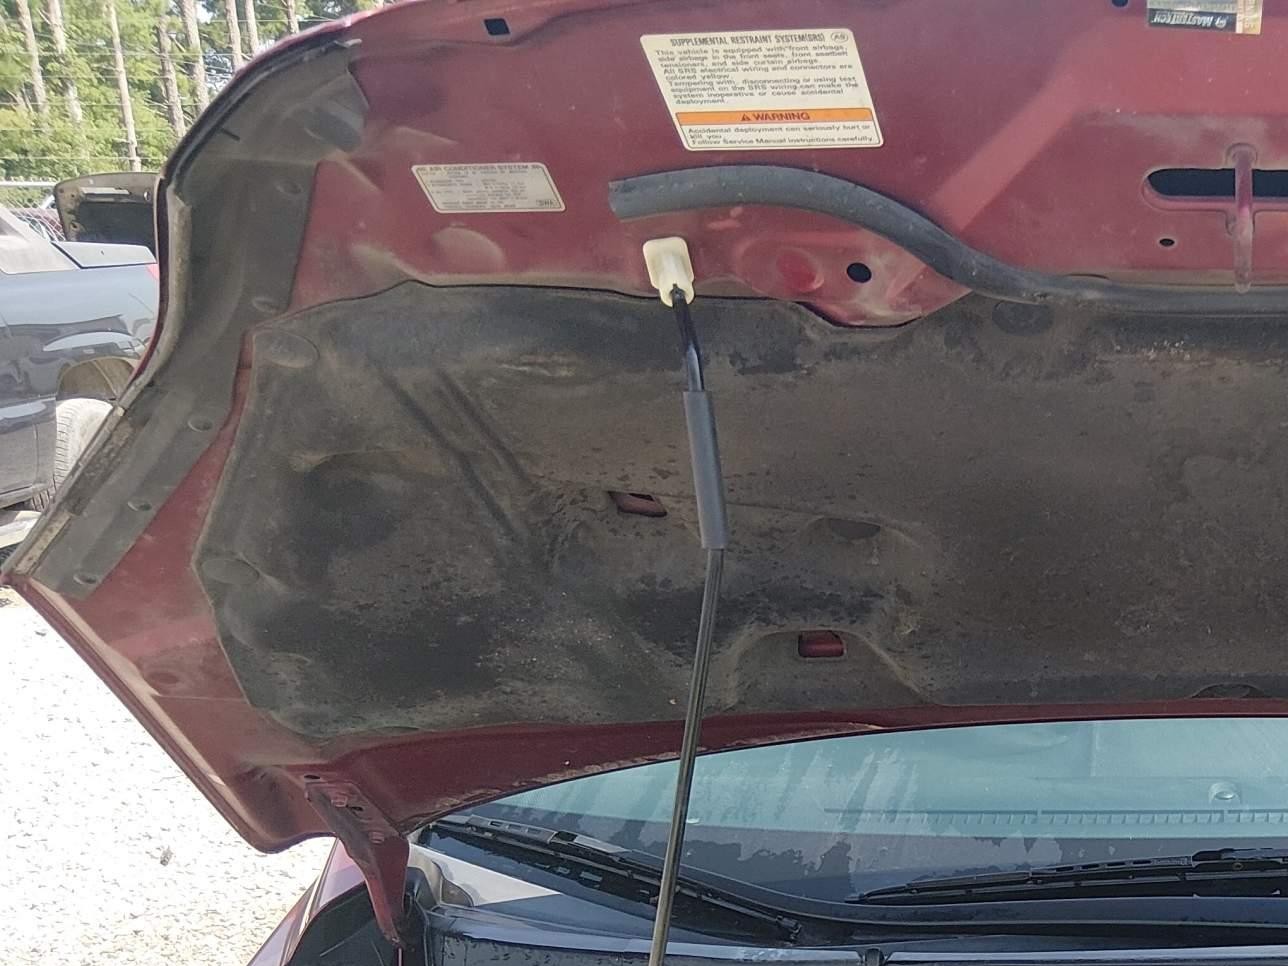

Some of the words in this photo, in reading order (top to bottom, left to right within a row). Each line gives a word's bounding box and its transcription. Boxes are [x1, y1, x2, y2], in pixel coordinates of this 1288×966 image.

[670, 37, 728, 46] SUPPLEMENTAL
[731, 34, 772, 44] RESTRAINT
[775, 32, 825, 43] SYSTEM(SRS)
[723, 47, 762, 55] equipped
[814, 76, 836, 84] using
[753, 112, 810, 122] WARNING
[803, 124, 840, 132] seriously
